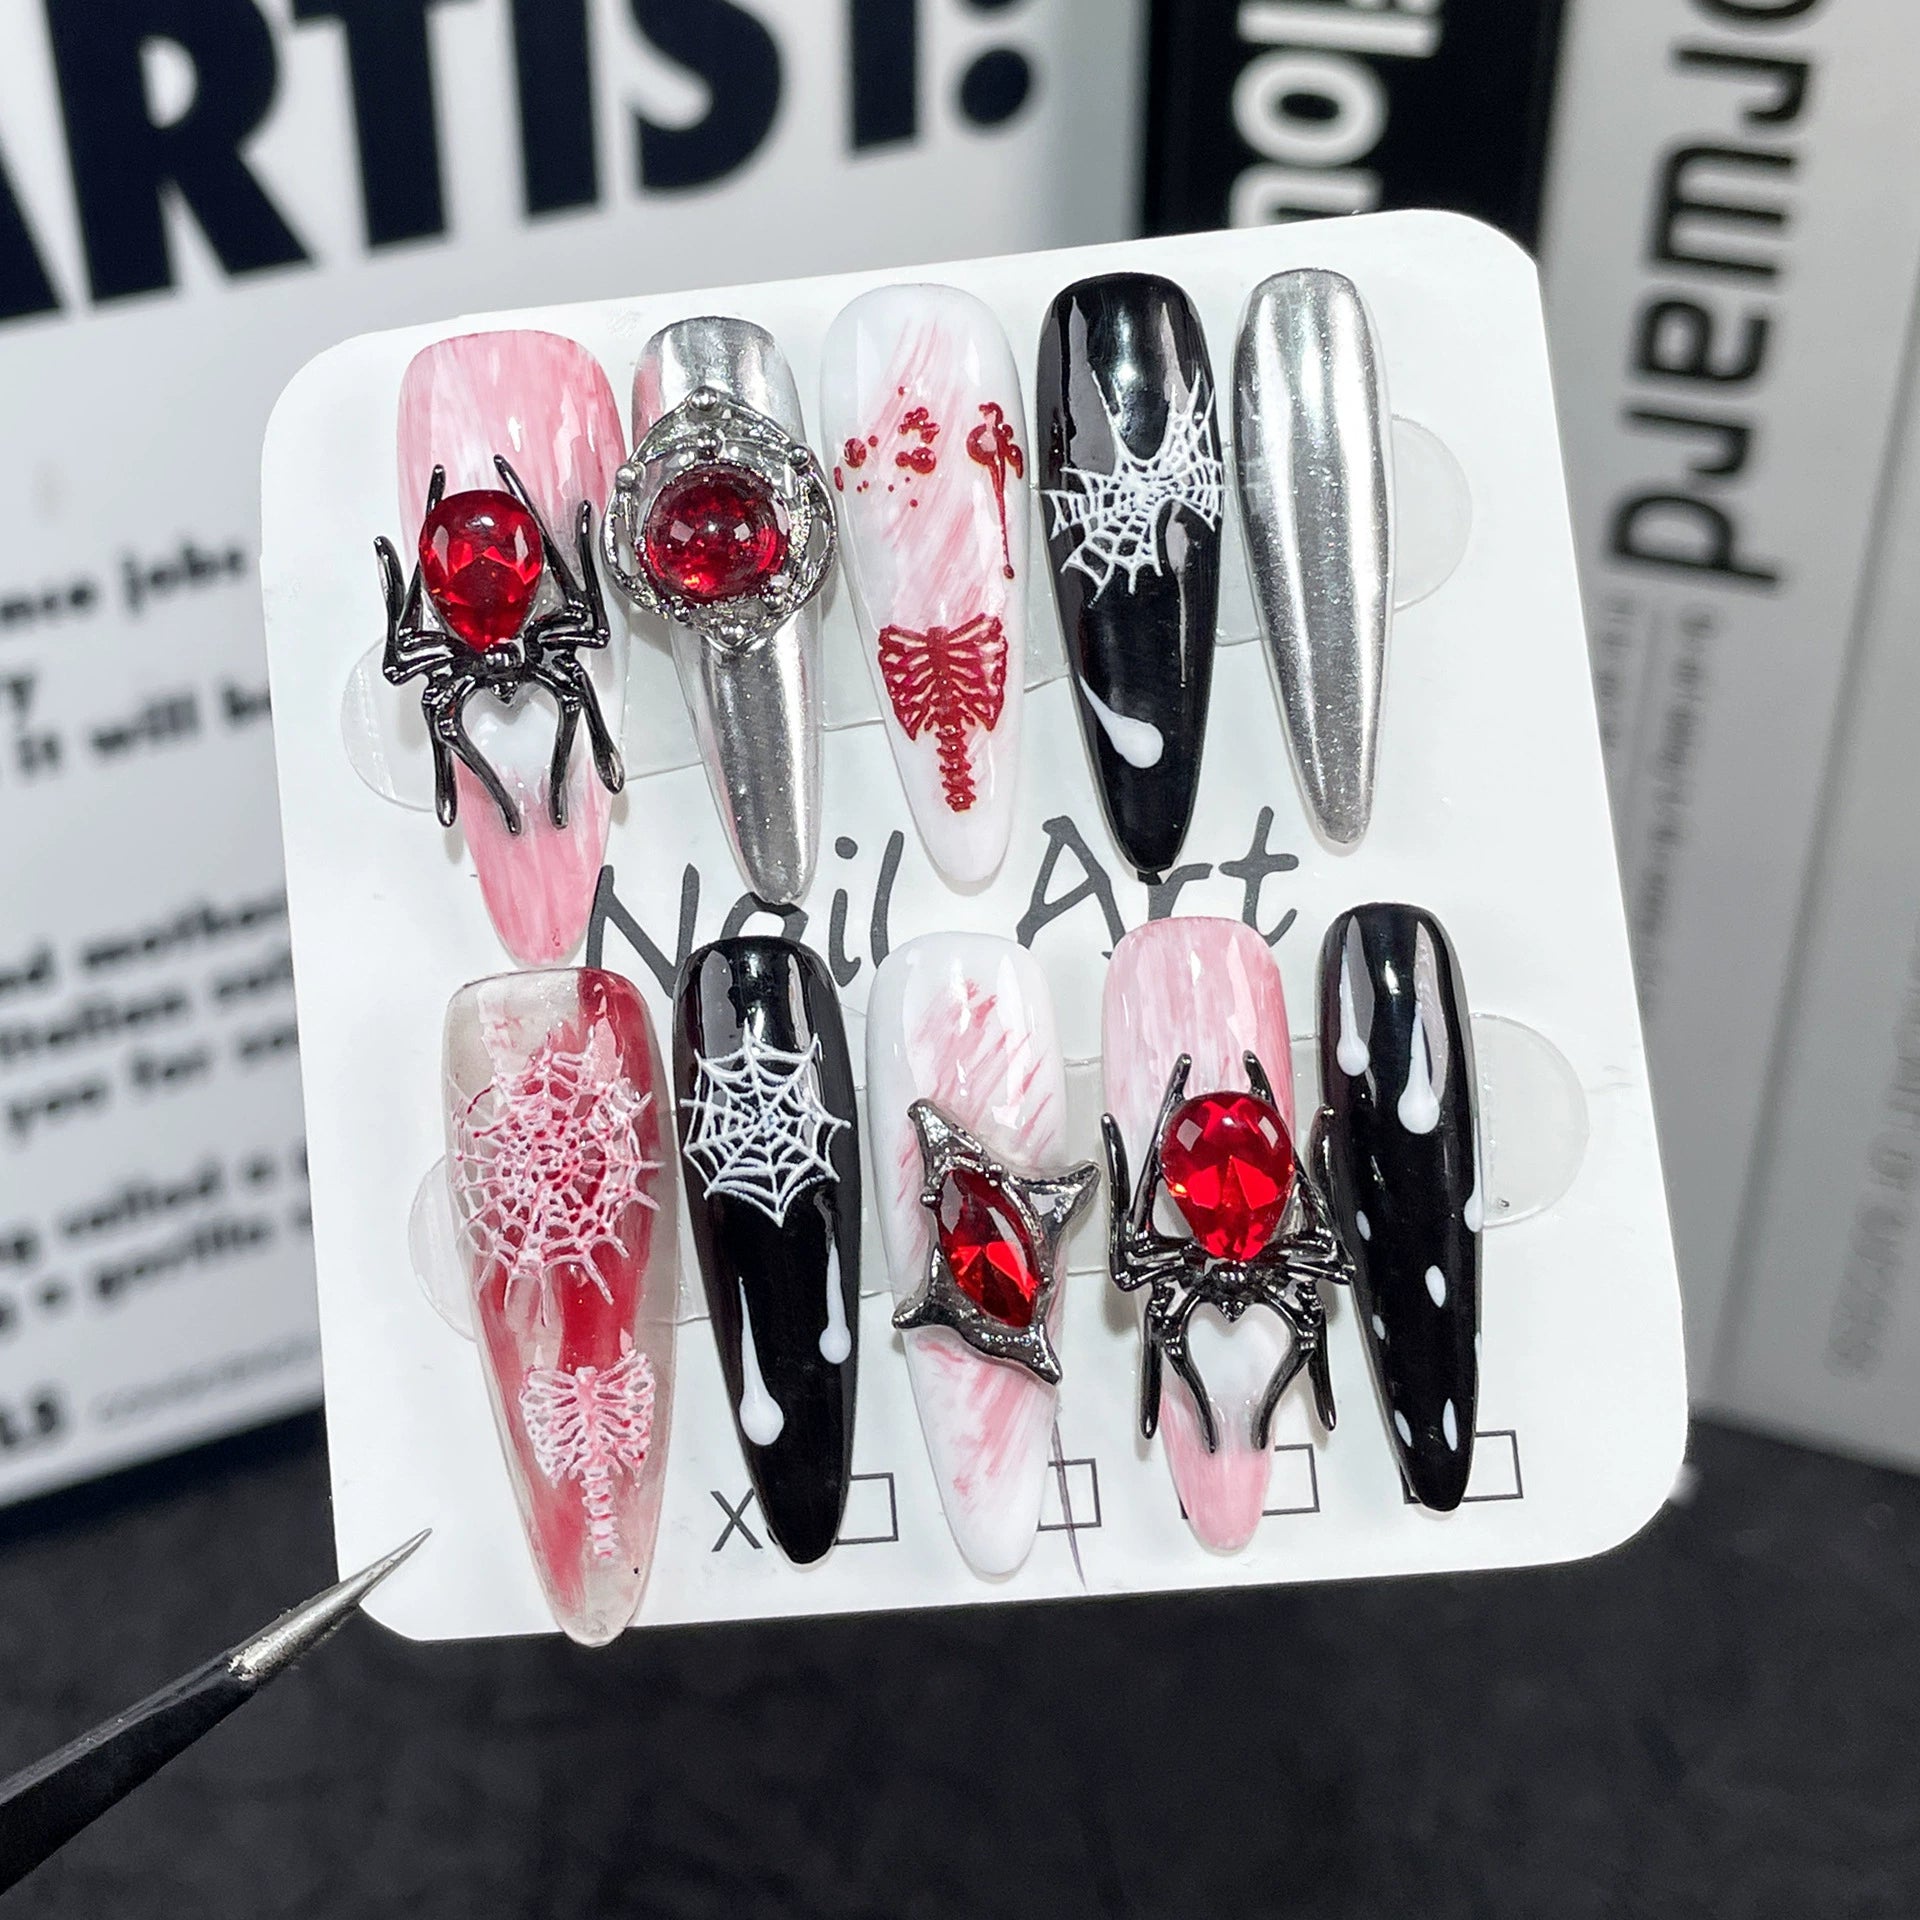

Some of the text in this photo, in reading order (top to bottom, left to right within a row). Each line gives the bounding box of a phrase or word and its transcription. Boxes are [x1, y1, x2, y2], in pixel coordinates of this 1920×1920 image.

[0, 0, 1035, 316] RTIS:
[1610, 0, 1812, 588] rward
[583, 805, 1300, 1000] Nail Art
[710, 1487, 780, 1553] X
